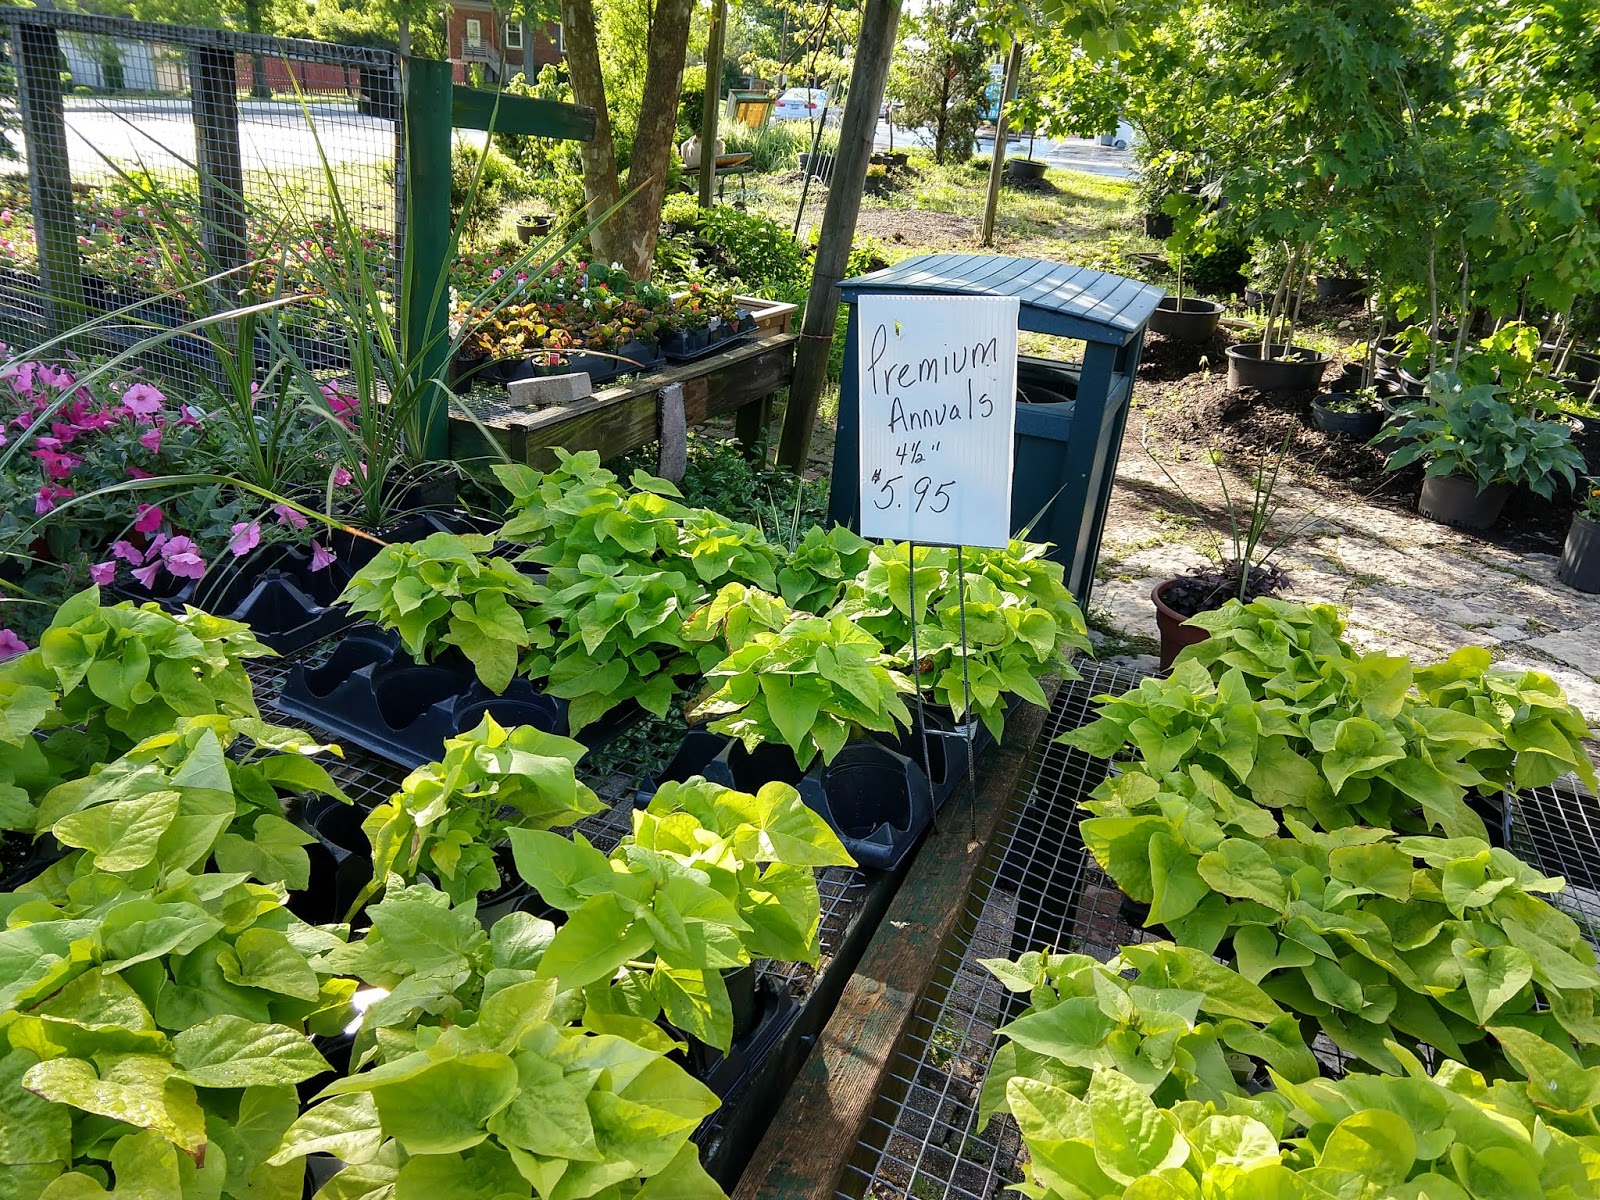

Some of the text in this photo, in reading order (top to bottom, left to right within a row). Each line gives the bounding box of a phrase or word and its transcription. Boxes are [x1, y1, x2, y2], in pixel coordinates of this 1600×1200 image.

[867, 323, 997, 396] Premium
[887, 377, 994, 434] Annuals
[870, 467, 957, 514] $5.95
